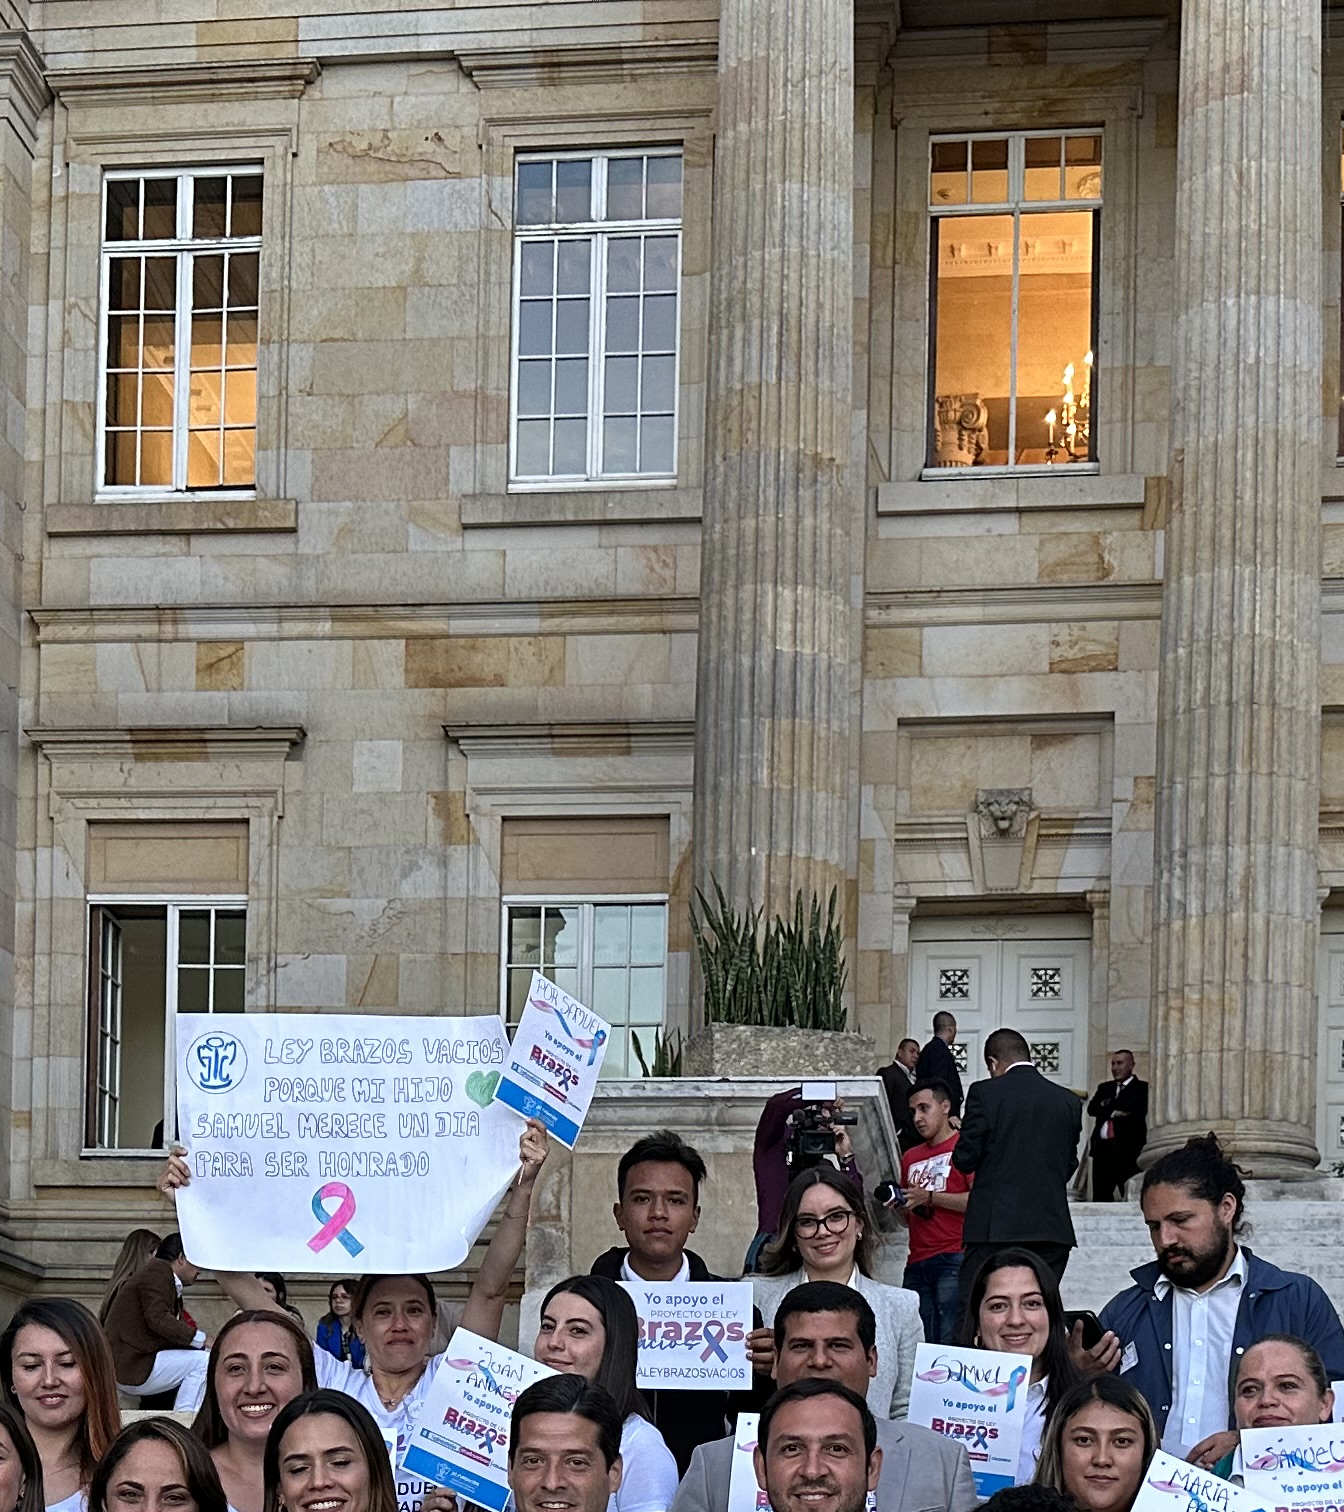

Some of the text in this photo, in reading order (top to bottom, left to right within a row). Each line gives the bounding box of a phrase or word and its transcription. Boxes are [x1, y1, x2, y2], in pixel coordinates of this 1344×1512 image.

[536, 978, 601, 1036] POR SAMUEL
[264, 1038, 504, 1065] LEY BRAZOS VACIOS
[554, 1037, 575, 1059] apoyo
[264, 1077, 452, 1103] PORQUE MI HIJO
[192, 1111, 480, 1139] SAMUEL MERECE UN DIA
[195, 1151, 429, 1177] PARA SER HONRADO
[644, 1293, 724, 1307] Yo apoyo el
[651, 1310, 702, 1318] PROYECTO
[463, 1390, 502, 1415] Yo apoyo
[943, 1398, 997, 1412] Yo apoyo el
[444, 1406, 507, 1447] Brazos
[931, 1418, 999, 1439] Brazos
[1281, 1480, 1342, 1493] Yo apoyo el
